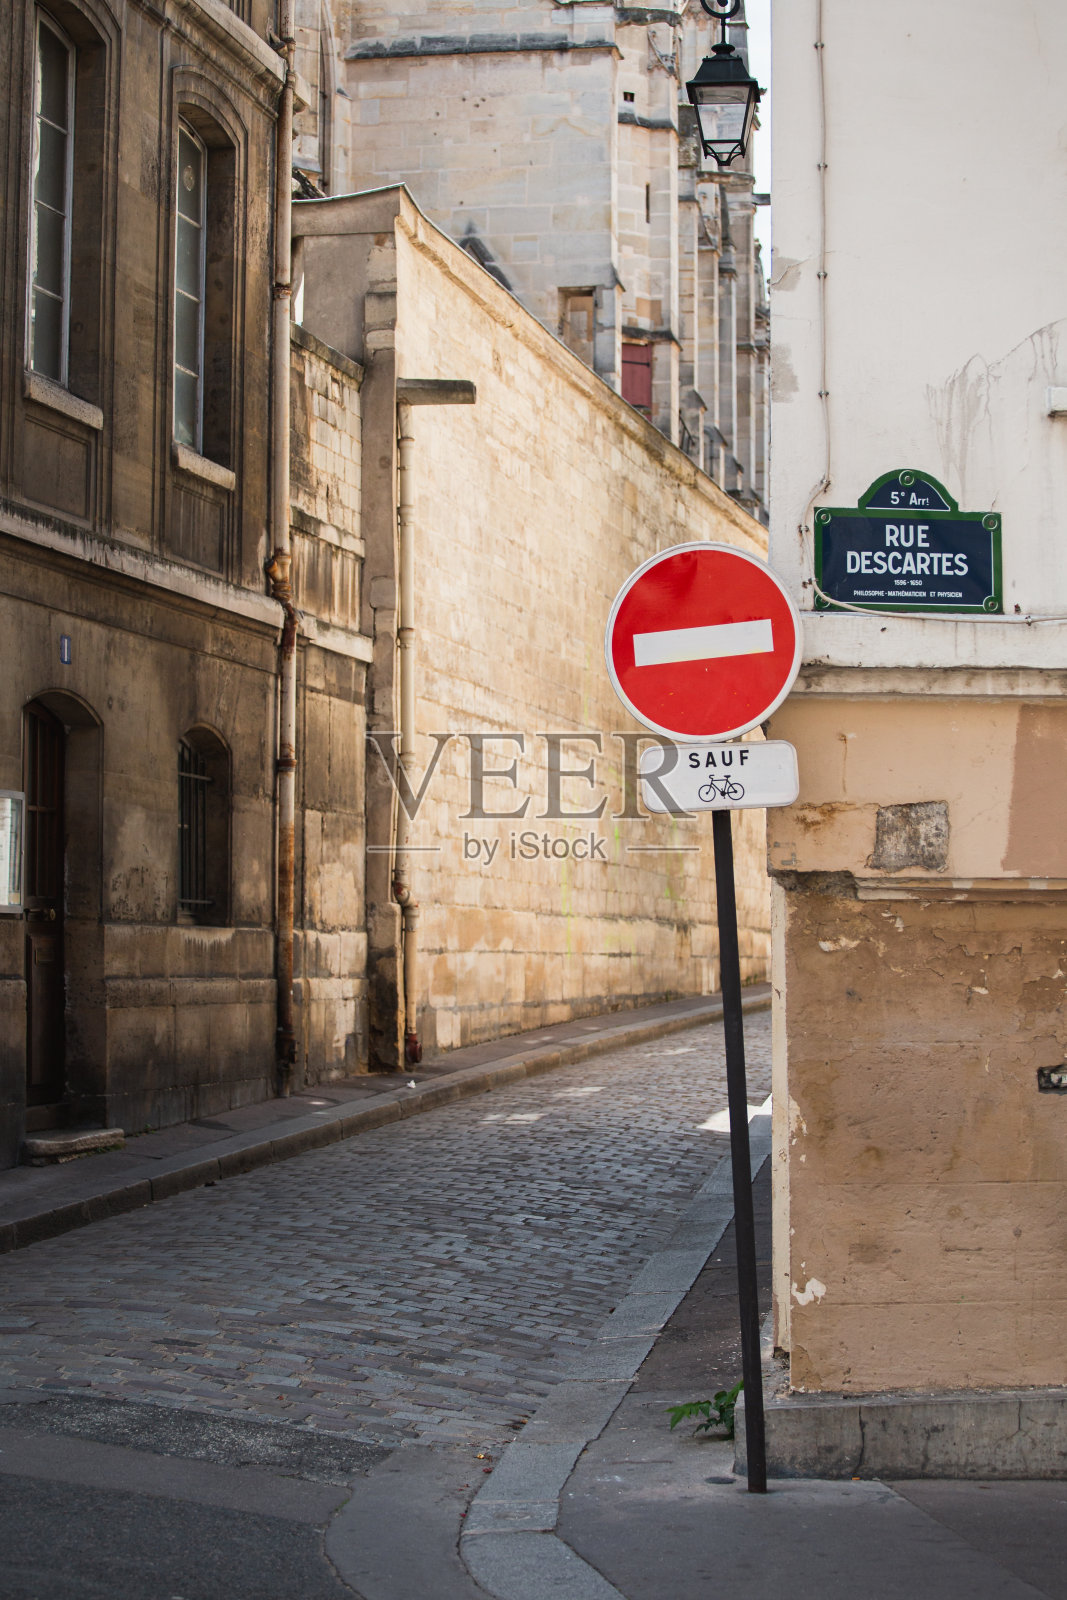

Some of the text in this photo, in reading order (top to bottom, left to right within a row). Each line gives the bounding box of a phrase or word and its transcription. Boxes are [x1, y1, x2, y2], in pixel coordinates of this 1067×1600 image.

[885, 524, 930, 548] RUE
[846, 550, 969, 576] DESCARTES
[688, 749, 750, 769] SAUF
